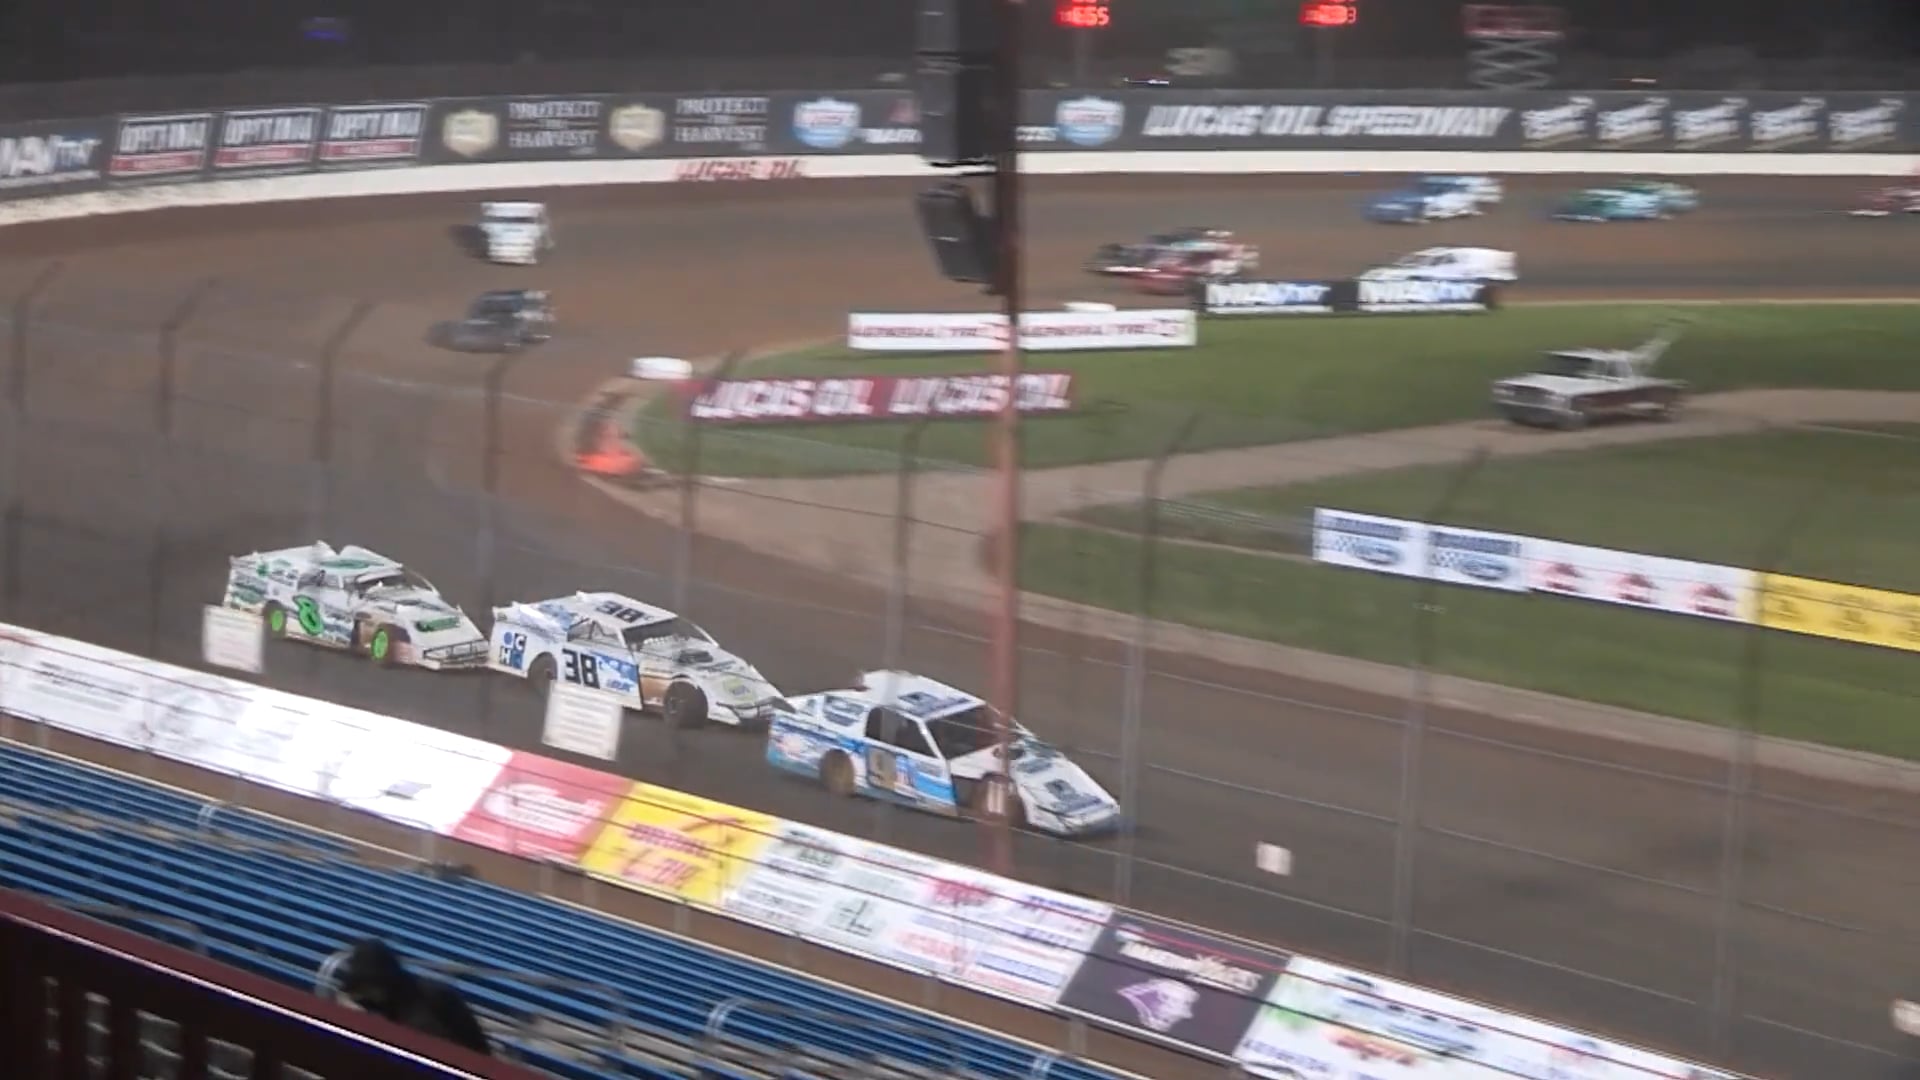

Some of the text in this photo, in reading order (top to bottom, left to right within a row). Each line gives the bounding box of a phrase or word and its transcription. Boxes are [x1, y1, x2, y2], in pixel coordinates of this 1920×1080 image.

[1142, 105, 1263, 136] LUCAS
[1260, 105, 1323, 135] OIL
[1321, 105, 1510, 137] SPEEDWAY
[596, 600, 644, 623] 38
[562, 648, 600, 690] 38
